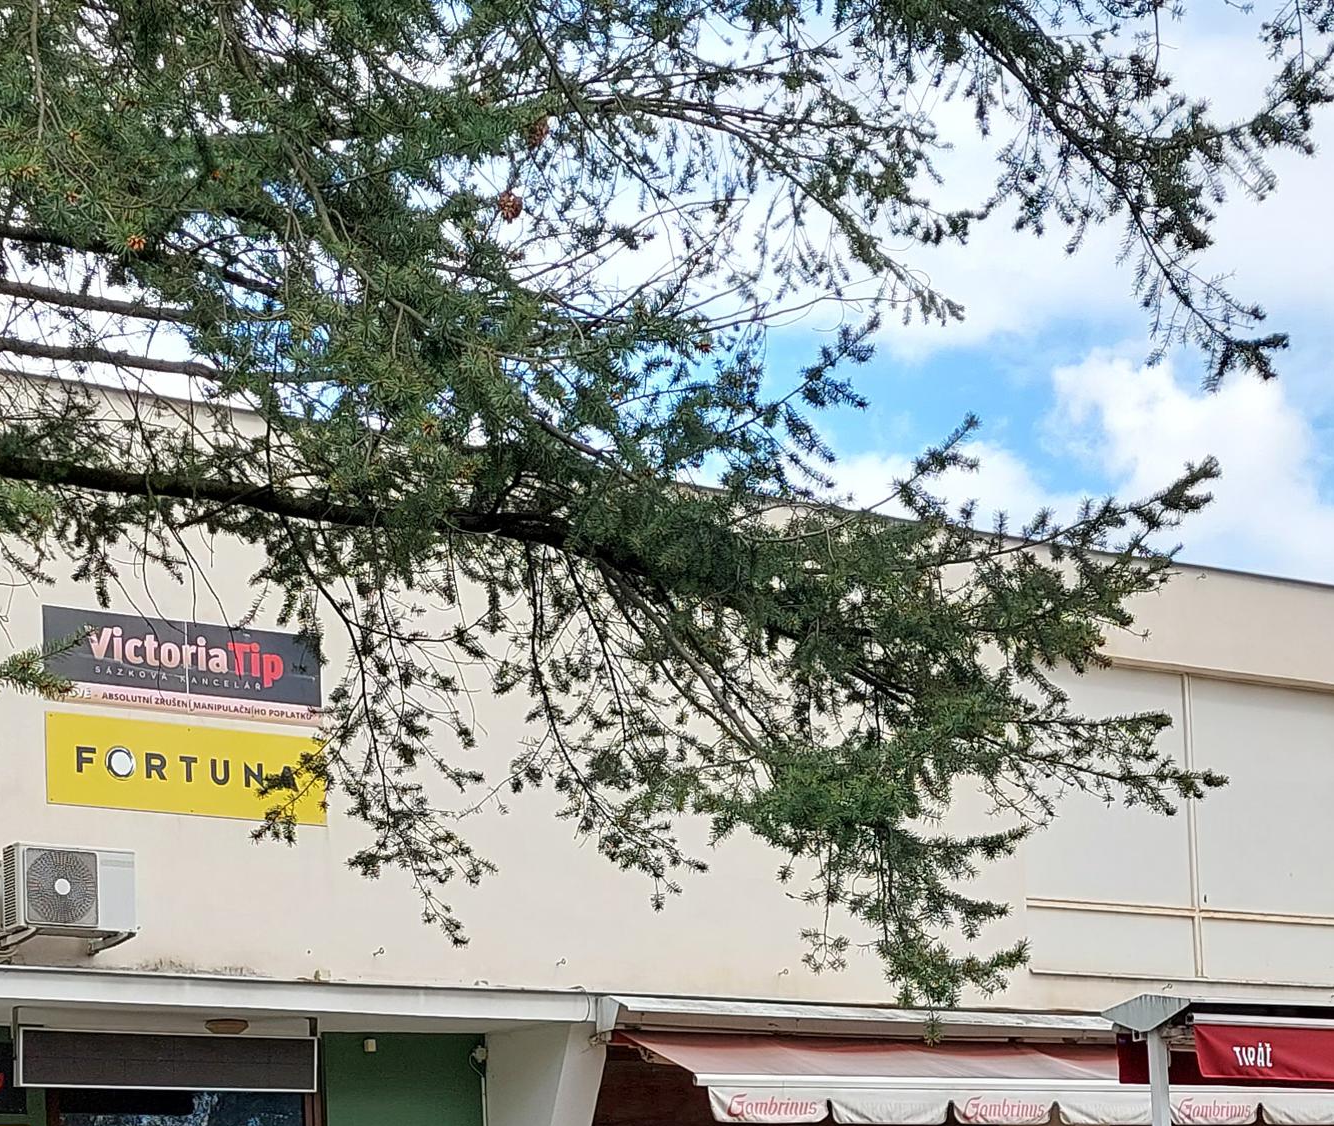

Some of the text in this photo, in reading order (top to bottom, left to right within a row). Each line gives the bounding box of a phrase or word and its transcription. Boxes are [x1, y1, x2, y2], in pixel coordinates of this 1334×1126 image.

[88, 626, 284, 689] VictoriaTip
[101, 692, 153, 705] ABSOLUTNÍ
[154, 696, 192, 709] ZRUŠENÍ
[193, 701, 267, 715] MANIPULAČNÍHO
[268, 708, 313, 720] POPLATKU
[75, 745, 299, 793] FORTUNA
[727, 1093, 817, 1118] Gambrinus
[963, 1095, 1045, 1120] Gambrinus
[1178, 1097, 1251, 1119] Gambrinus
